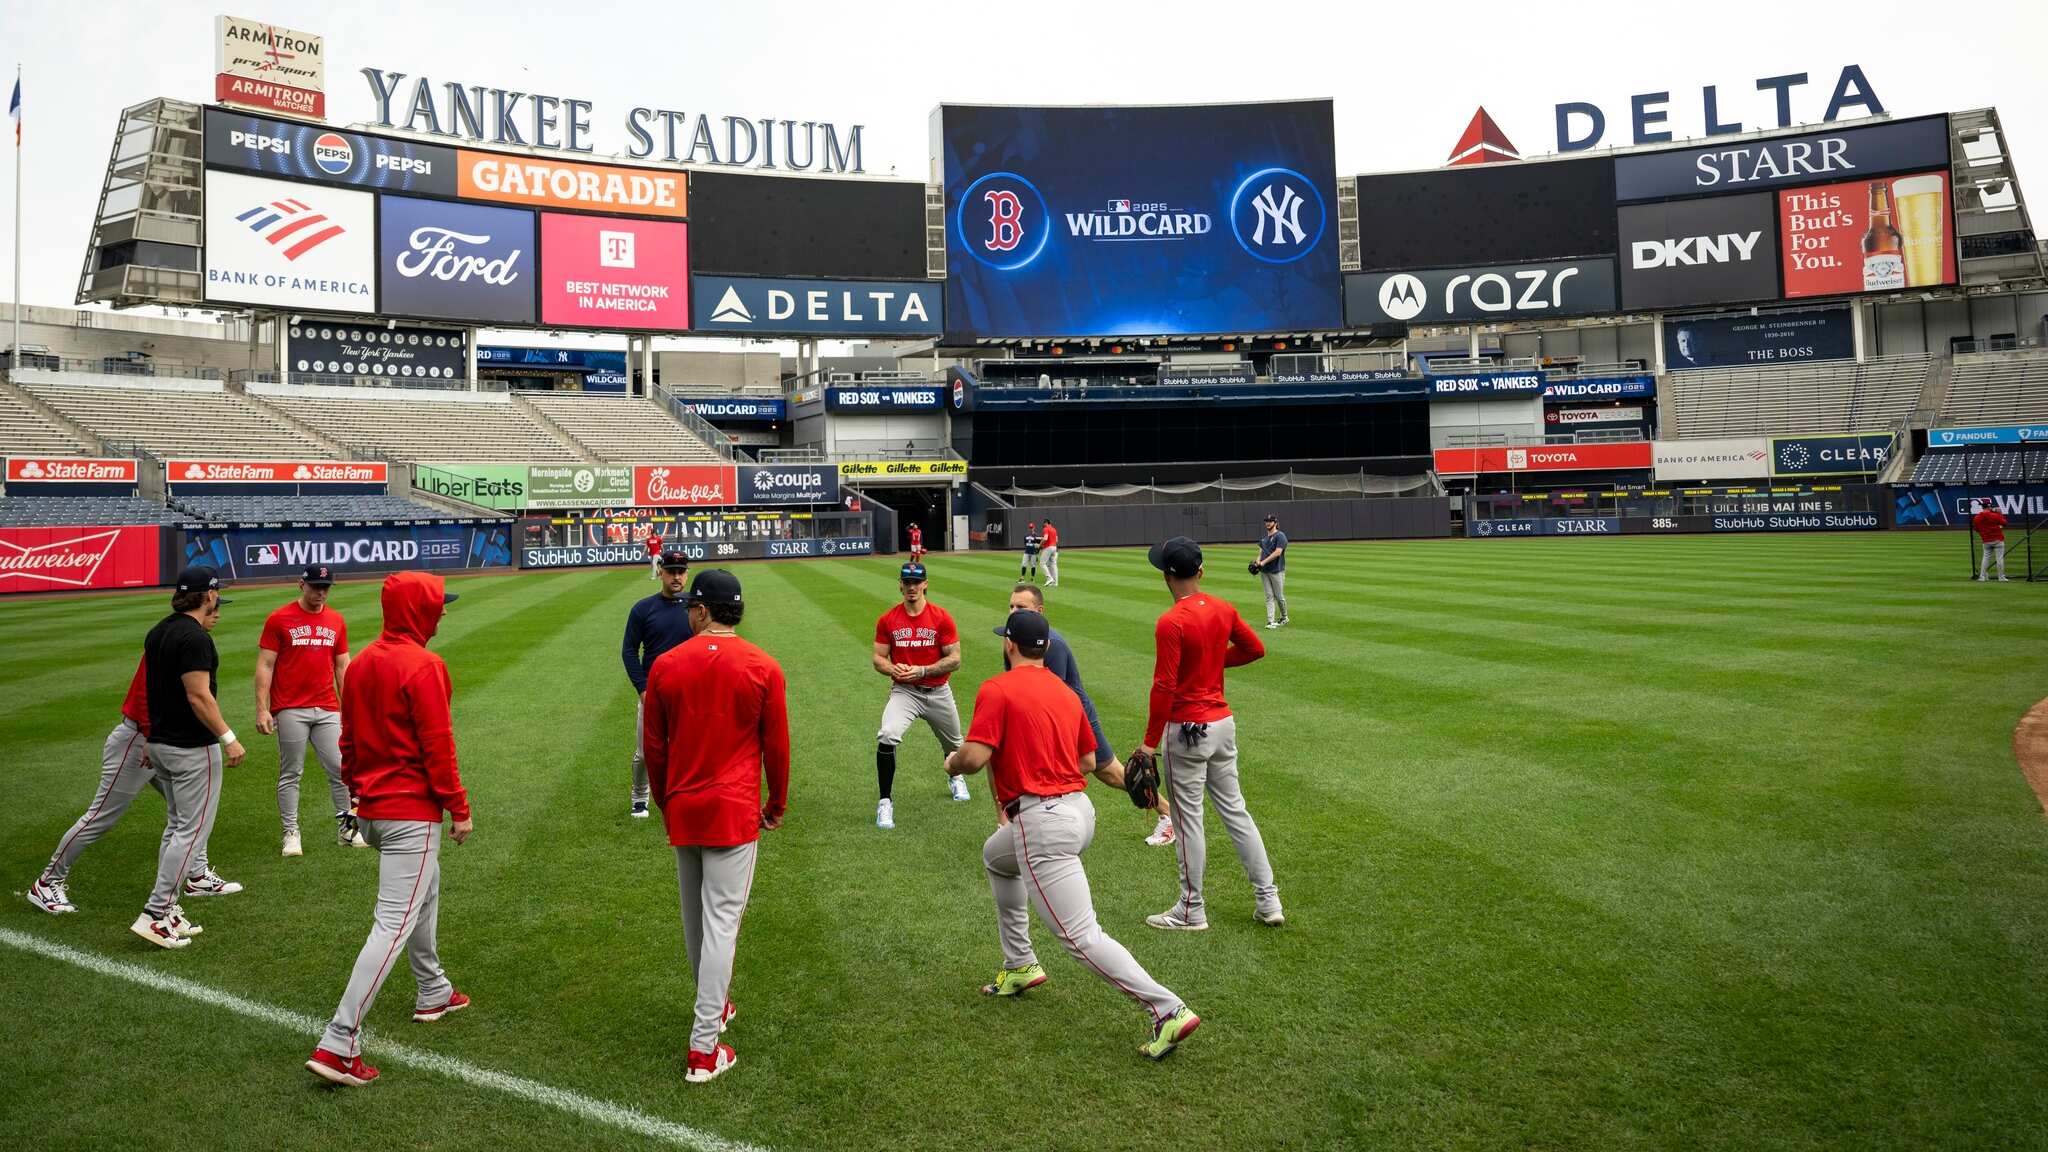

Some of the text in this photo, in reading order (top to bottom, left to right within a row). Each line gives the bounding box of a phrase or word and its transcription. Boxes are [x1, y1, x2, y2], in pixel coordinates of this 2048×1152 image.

[226, 26, 320, 55] ARMITRON
[232, 80, 315, 105] ARMITRON
[273, 99, 314, 112] WATCHES
[1555, 63, 1885, 154] DELTA
[360, 66, 865, 173] YANKEE STADIUM
[230, 130, 431, 175] PEPSI PEPSI PEPSI
[1695, 138, 1855, 186] STARR
[472, 159, 676, 208] GATORADE
[1132, 202, 1167, 212] 2025
[1787, 192, 1840, 212] This
[985, 190, 1024, 251] B
[1788, 209, 1853, 231] Bud's
[1632, 230, 1762, 270] DKNY
[1790, 233, 1830, 251] For
[396, 226, 521, 288] Ford
[1790, 253, 1842, 270] You.
[209, 269, 369, 296] BANK OF AMERICA
[566, 281, 669, 299] BEST NETWORK
[1445, 267, 1579, 314] razr
[579, 297, 657, 313] IN AMERICA
[767, 289, 929, 323] DELTA
[1732, 324, 1759, 332] GEORGE
[1768, 320, 1817, 329] STEINBRENNER
[341, 345, 415, 362] New York Yankees
[1748, 346, 1814, 360] THE BOSS
[1436, 380, 1456, 392] RED
[1458, 378, 1478, 391] SOX
[1492, 376, 1539, 390] YANKEES
[840, 392, 859, 404] RED
[860, 392, 880, 404] SOX
[892, 392, 935, 404] YANKEES
[1956, 432, 1998, 440] FANDUEL
[1530, 453, 1577, 463] TOYOTA
[1700, 454, 1745, 463] AMERICA
[1820, 447, 1884, 461] CLEAR
[532, 467, 572, 479] Morningside
[842, 463, 964, 474] Gillette Gillette Gillette
[422, 477, 523, 497] Uber Eats
[610, 478, 630, 487] Circle
[648, 474, 724, 503] Chick-fil-A
[775, 473, 821, 490] coupa
[1557, 520, 1608, 533] STARR
[1715, 516, 1878, 528] StubHub StubHub StubHub
[422, 544, 460, 555] 2025
[771, 541, 809, 554] STARR
[0, 547, 102, 569] udweiser
[528, 548, 582, 566] StubHub
[587, 547, 641, 562] StubHub
